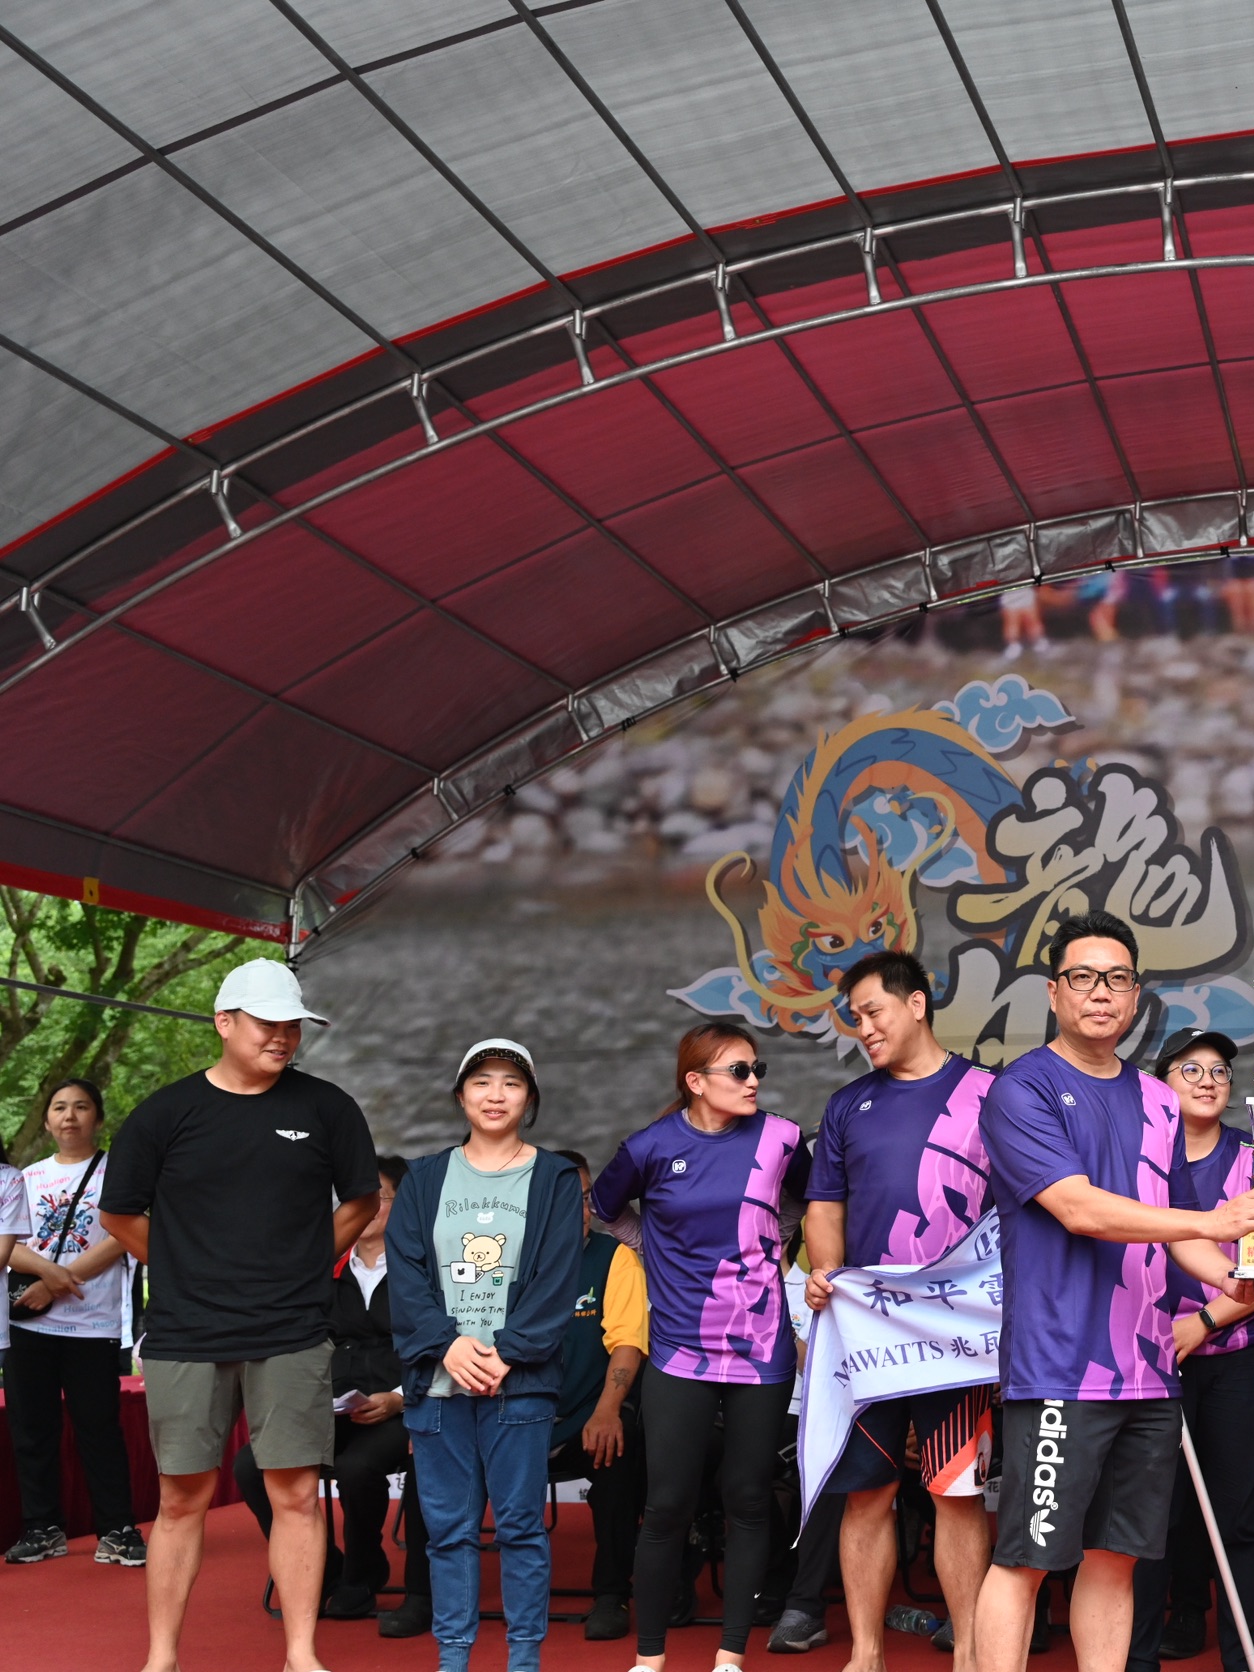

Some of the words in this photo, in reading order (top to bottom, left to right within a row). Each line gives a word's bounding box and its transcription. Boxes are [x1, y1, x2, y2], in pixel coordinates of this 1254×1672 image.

[460, 1289, 465, 1302] I
[470, 1291, 496, 1301] ENJOY
[1033, 1399, 1068, 1506] didas
